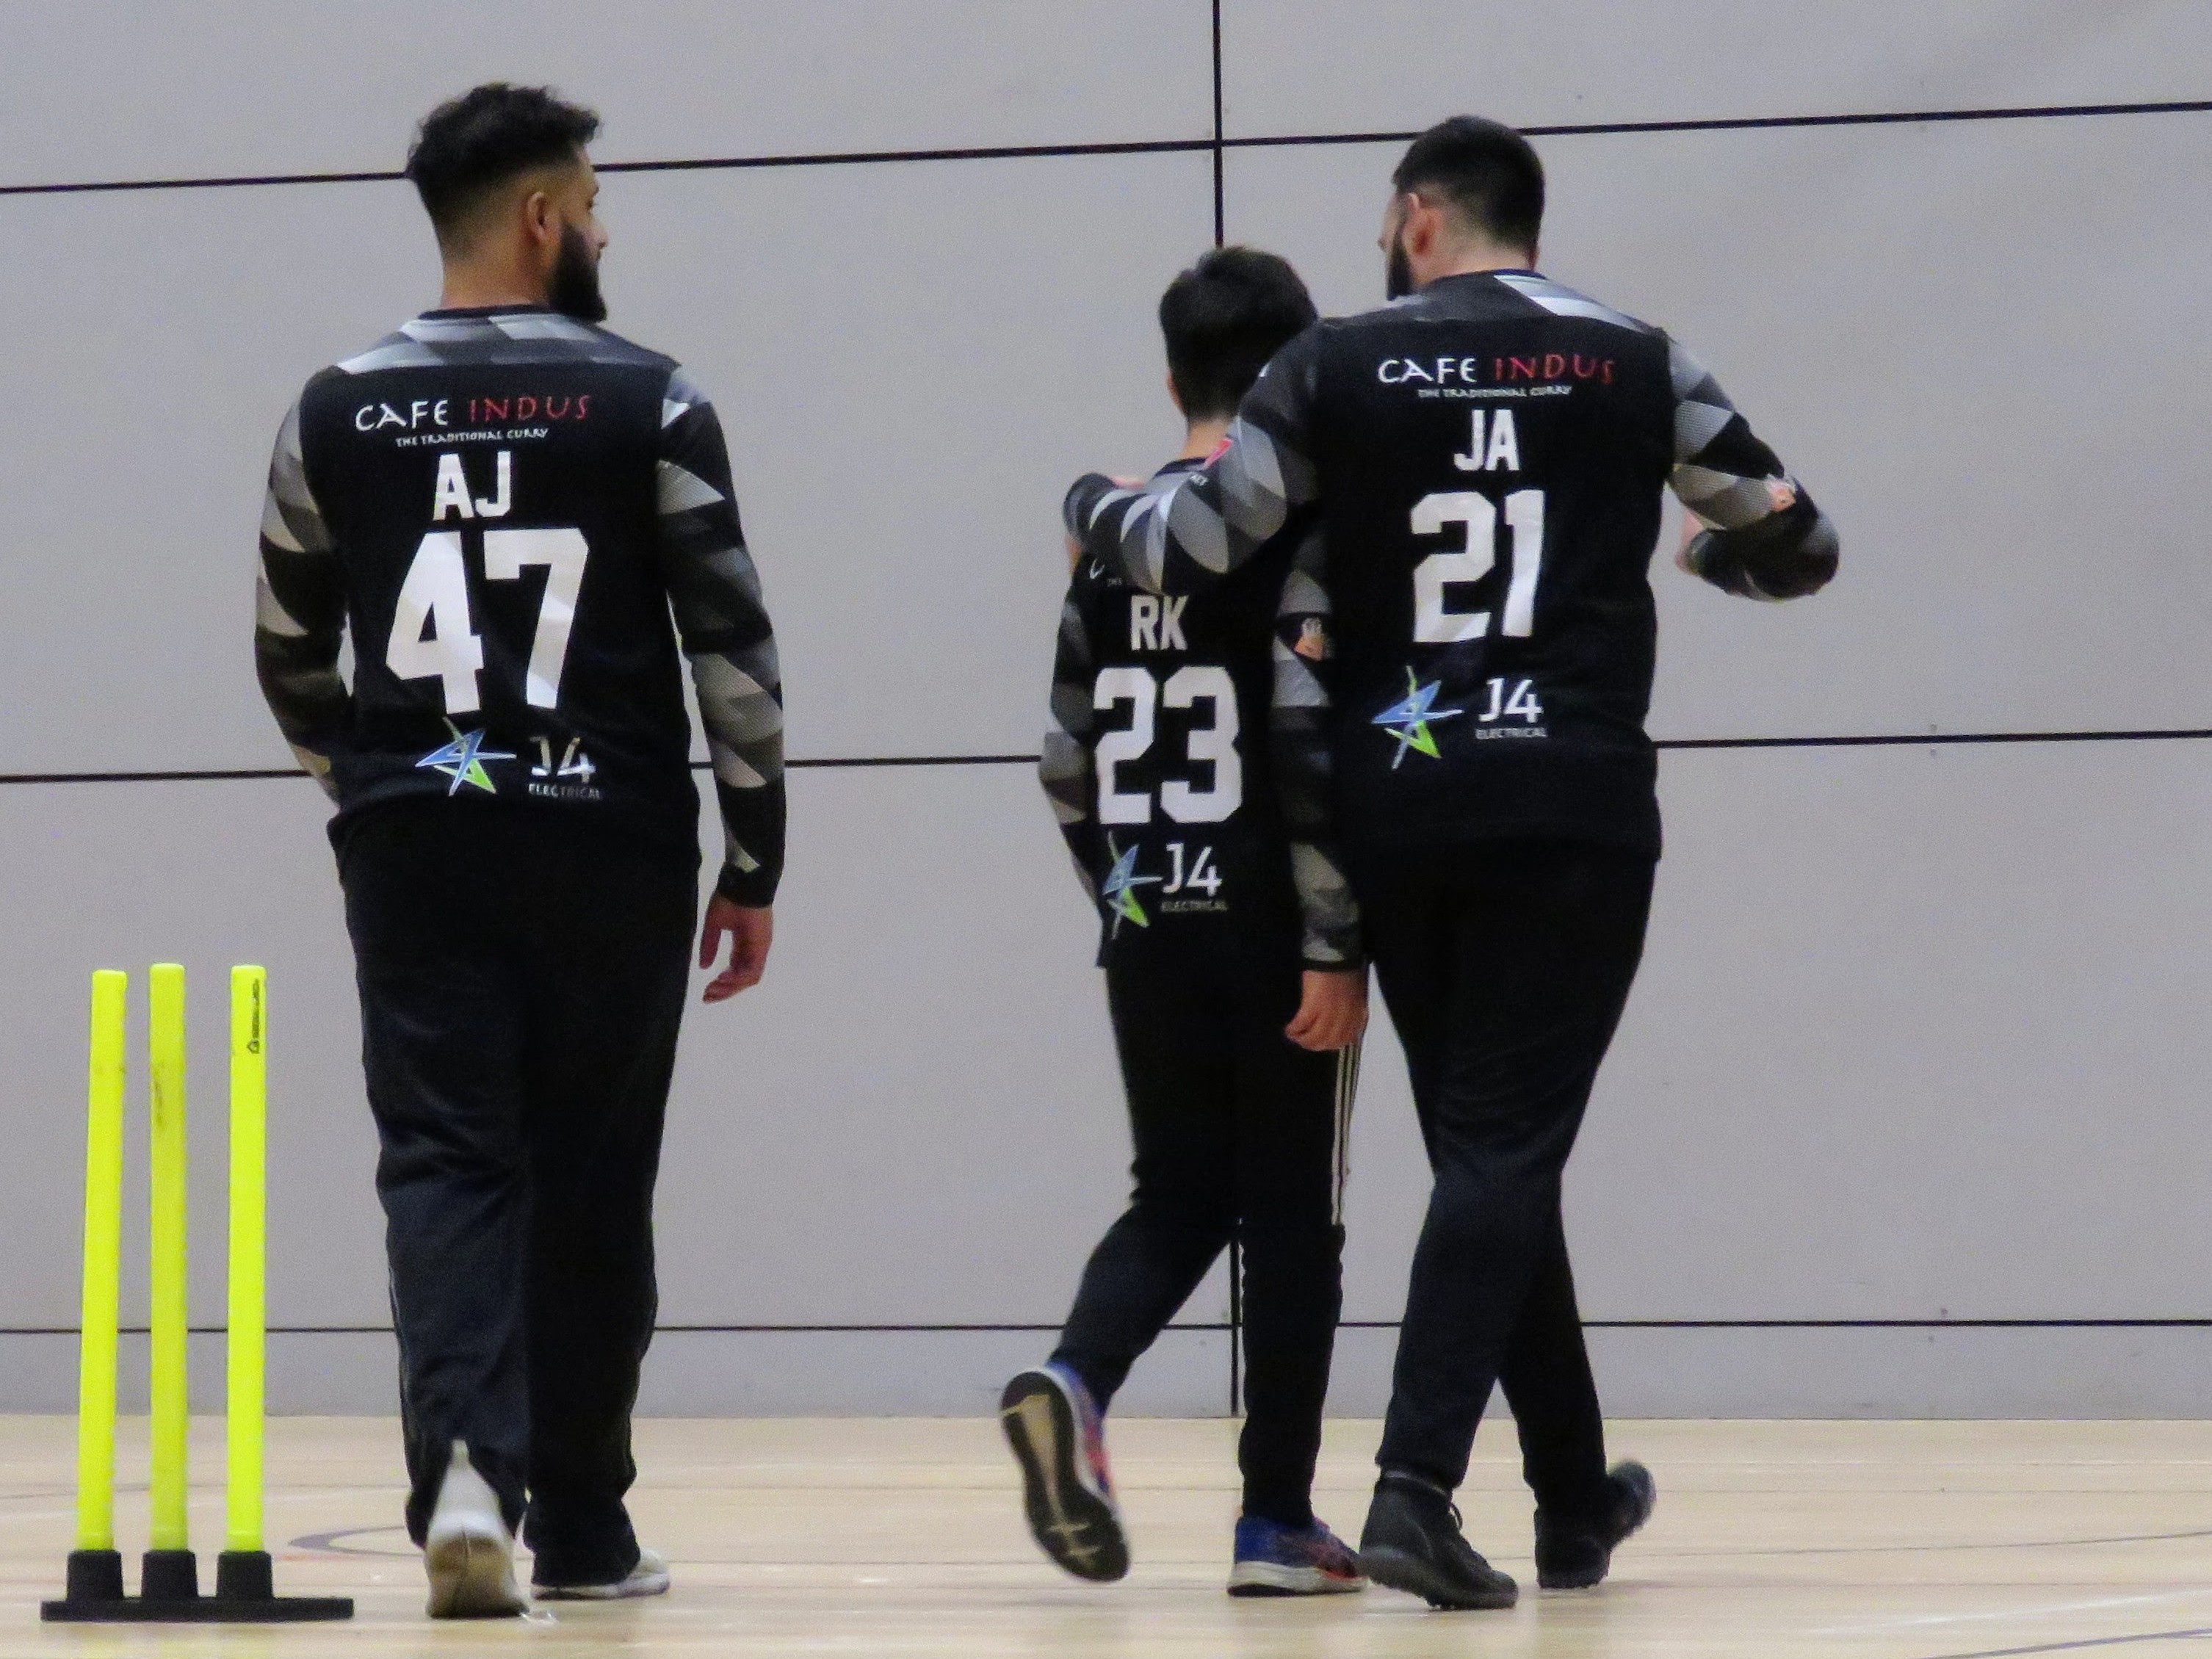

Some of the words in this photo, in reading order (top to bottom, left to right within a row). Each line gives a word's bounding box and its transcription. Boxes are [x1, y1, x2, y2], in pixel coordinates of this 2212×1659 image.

[1377, 357, 1478, 384] CAFE
[355, 399, 449, 432] CAFE
[469, 394, 591, 423] INDUS
[395, 435, 419, 449] THE
[420, 430, 503, 447] TRADITIONAL
[506, 427, 549, 439] CURRY
[1453, 408, 1520, 471] JA
[432, 450, 513, 522] AJ
[1410, 489, 1545, 643] 21
[385, 527, 590, 715] 47
[1130, 594, 1190, 651] RK
[1478, 676, 1544, 724] J4
[529, 735, 597, 784] J4
[1093, 665, 1243, 825] 23
[528, 783, 601, 800] ELECTRICAL
[1162, 842, 1223, 897] J4
